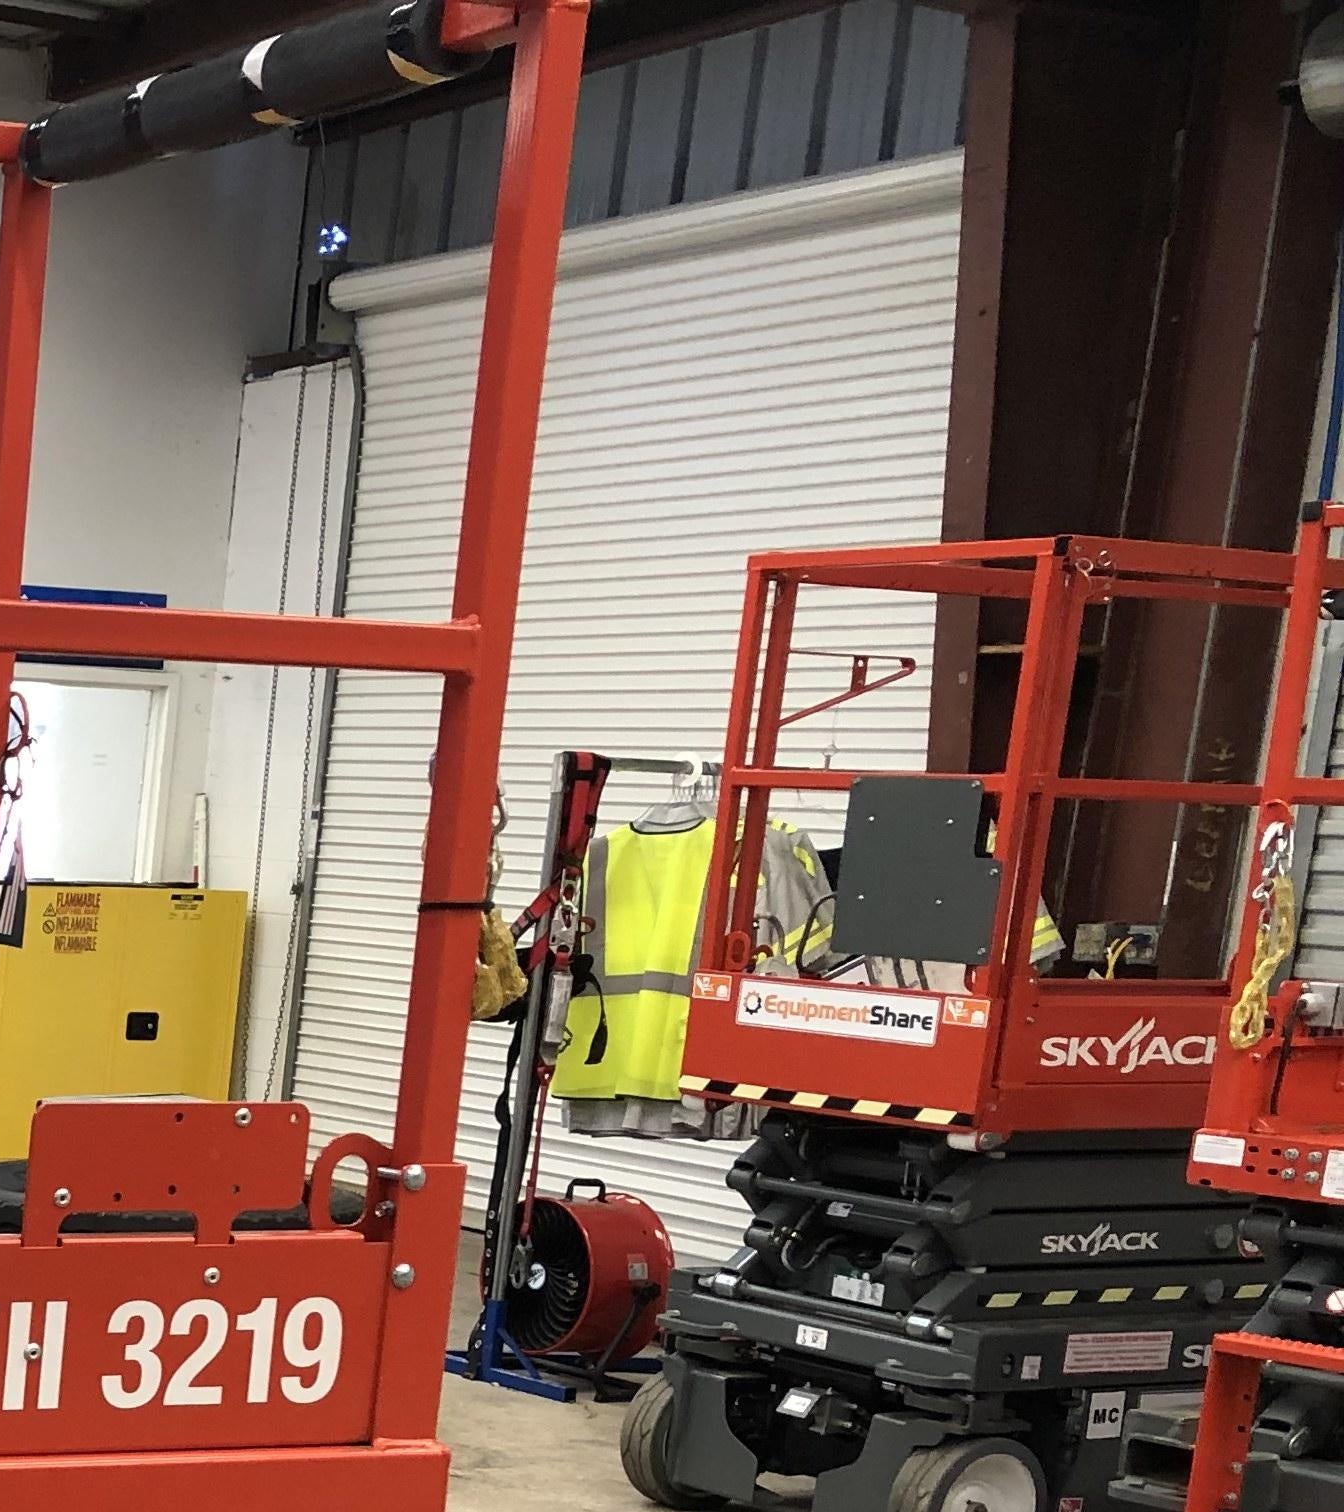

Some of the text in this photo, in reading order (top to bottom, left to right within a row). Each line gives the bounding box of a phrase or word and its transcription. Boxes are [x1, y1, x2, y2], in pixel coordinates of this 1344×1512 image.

[56, 892, 101, 908] FLAMMABLE
[763, 994, 934, 1031] EquipmentShare
[1040, 1222, 1160, 1257] SKYJACK
[100, 1296, 343, 1409] 3219
[1093, 1407, 1120, 1424] MC
